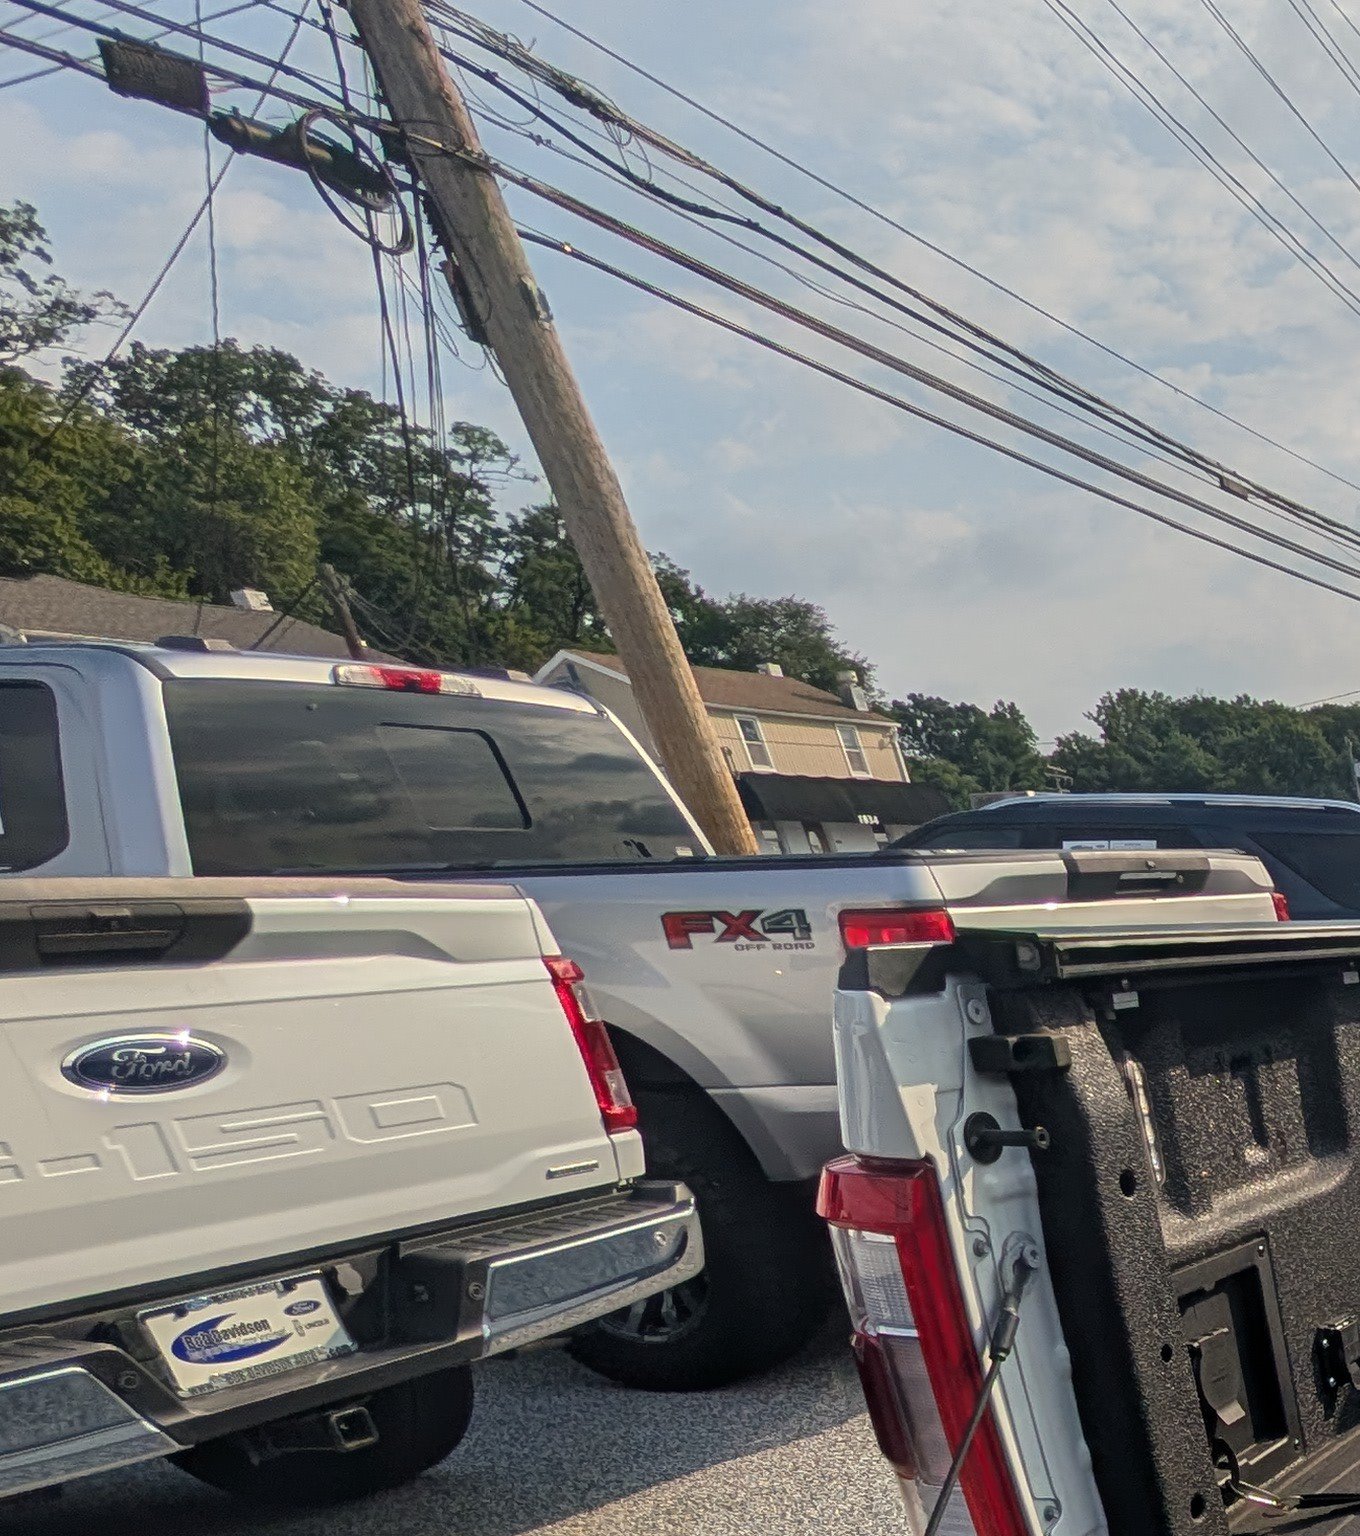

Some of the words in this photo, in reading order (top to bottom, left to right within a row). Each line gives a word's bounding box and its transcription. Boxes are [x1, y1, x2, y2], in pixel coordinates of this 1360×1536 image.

[660, 908, 813, 950] FX4
[734, 943, 767, 951] OFF
[772, 942, 815, 950] ROAD
[112, 1046, 196, 1078] Ford
[184, 1330, 213, 1350] Bob
[211, 1319, 272, 1344] Davidson
